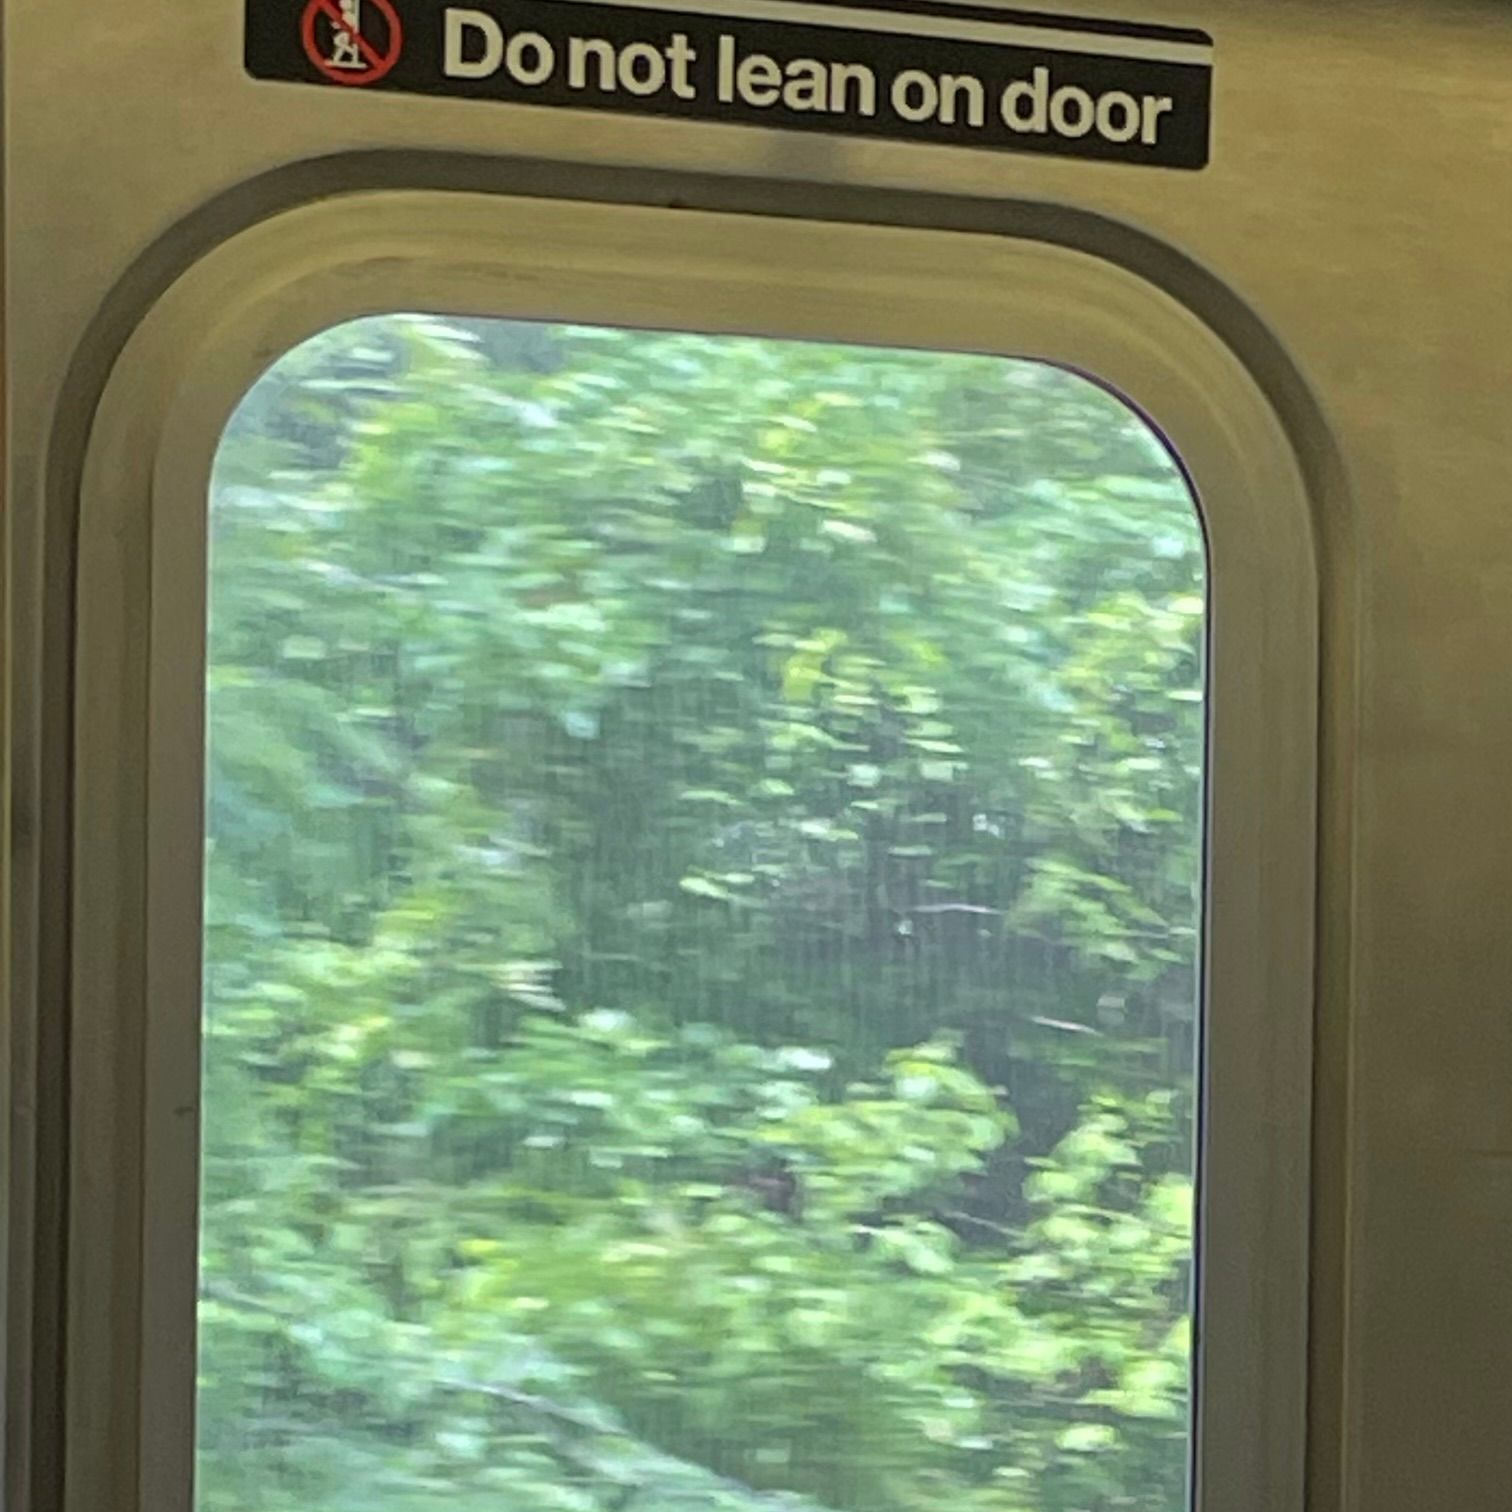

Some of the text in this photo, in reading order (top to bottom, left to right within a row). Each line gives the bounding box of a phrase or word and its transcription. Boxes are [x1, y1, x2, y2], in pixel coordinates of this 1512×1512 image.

[442, 6, 1174, 146] Do not lean on door
